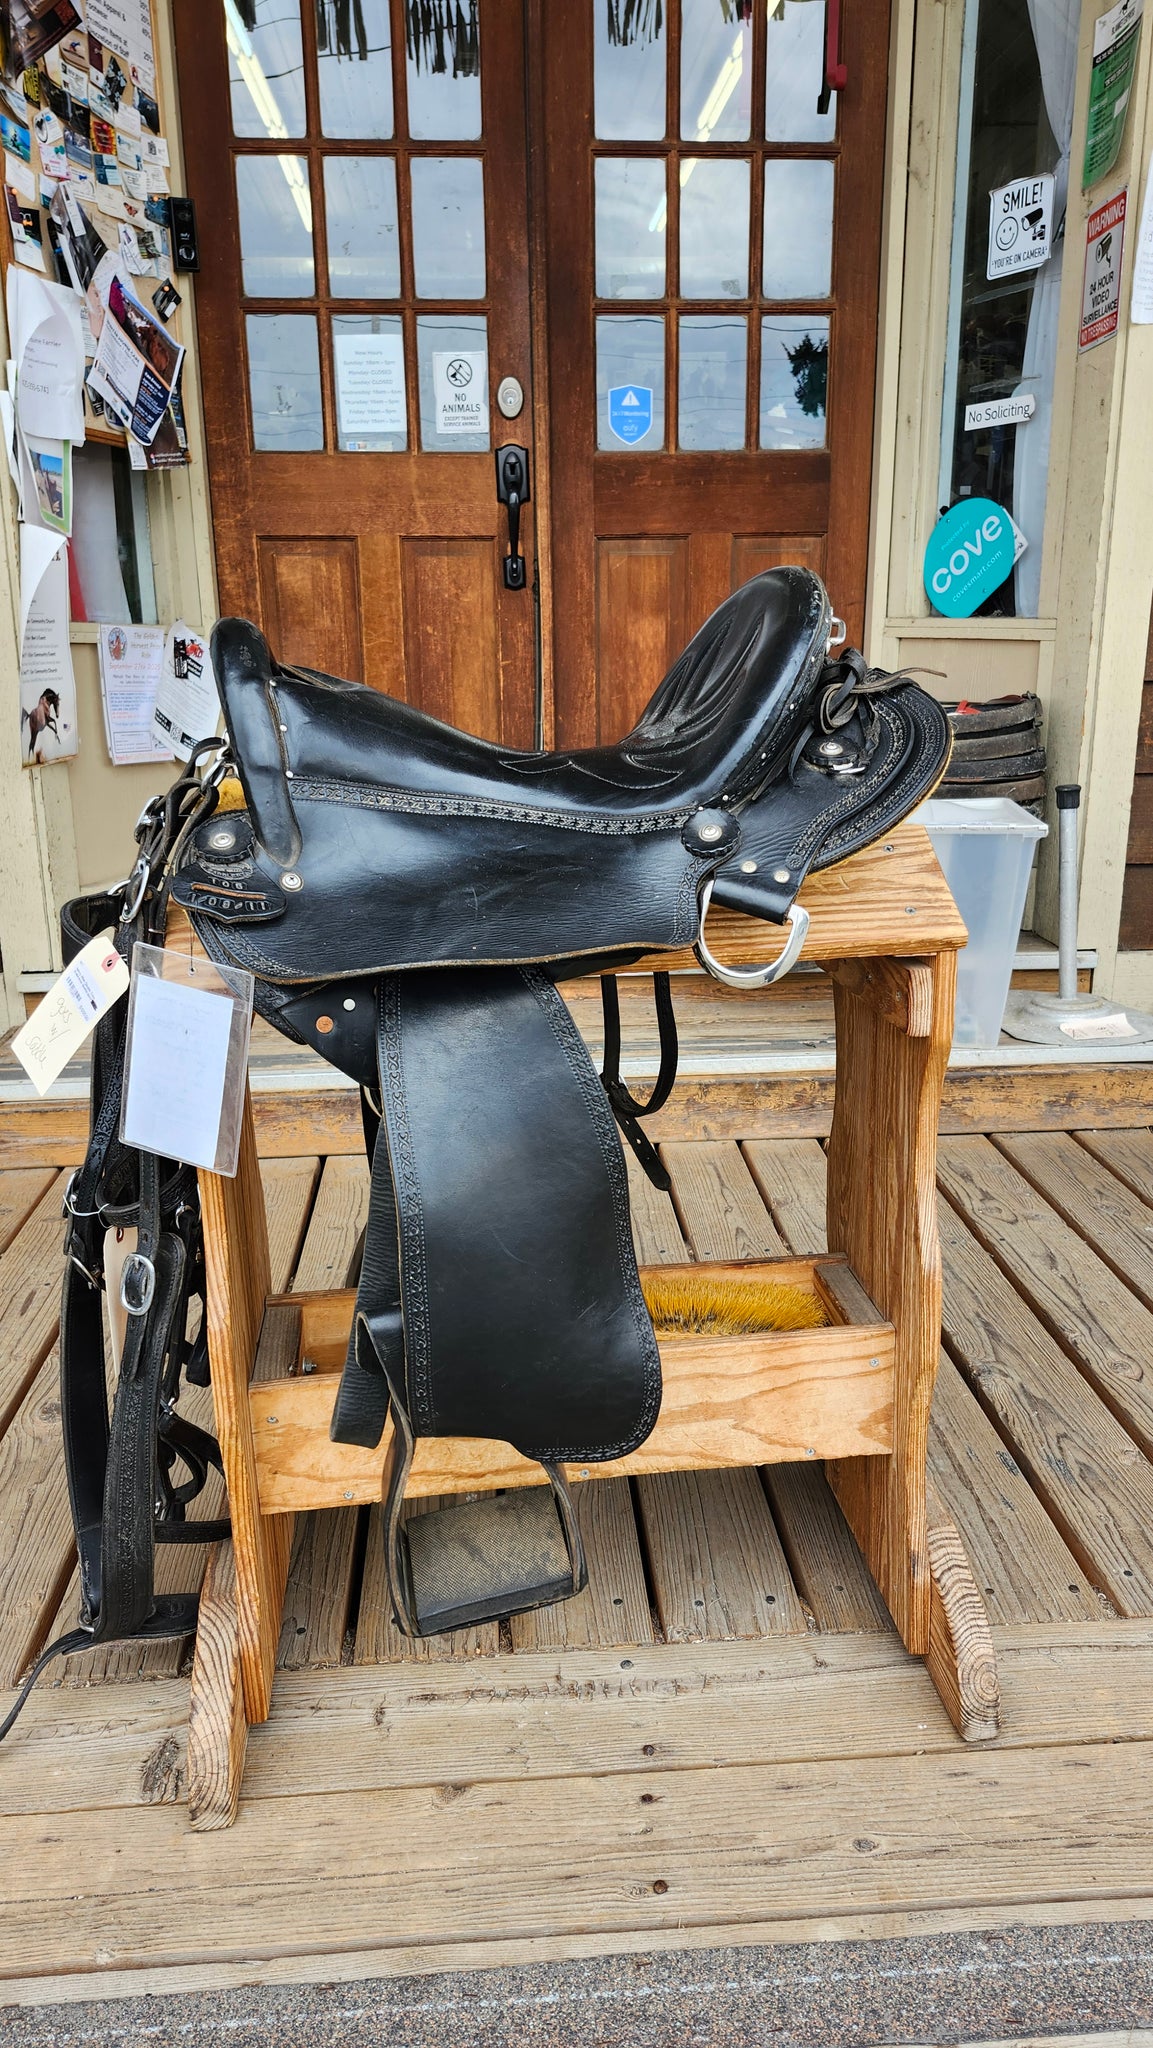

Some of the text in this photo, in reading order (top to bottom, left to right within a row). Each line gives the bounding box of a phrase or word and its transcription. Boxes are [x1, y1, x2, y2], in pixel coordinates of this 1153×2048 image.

[1003, 182, 1043, 213] SMILE!
[1088, 199, 1125, 239] WARNING
[1014, 253, 1021, 263] ON
[1089, 271, 1114, 295] 24 HOUR
[1091, 290, 1110, 308] VIDEO
[1082, 299, 1118, 326] SURVEILLANCE
[443, 404, 480, 412] ANIMALS
[455, 393, 466, 401] NO
[969, 403, 1030, 423] No Soliciting
[932, 515, 1002, 593] cove
[953, 550, 1002, 602] covesmart.com
